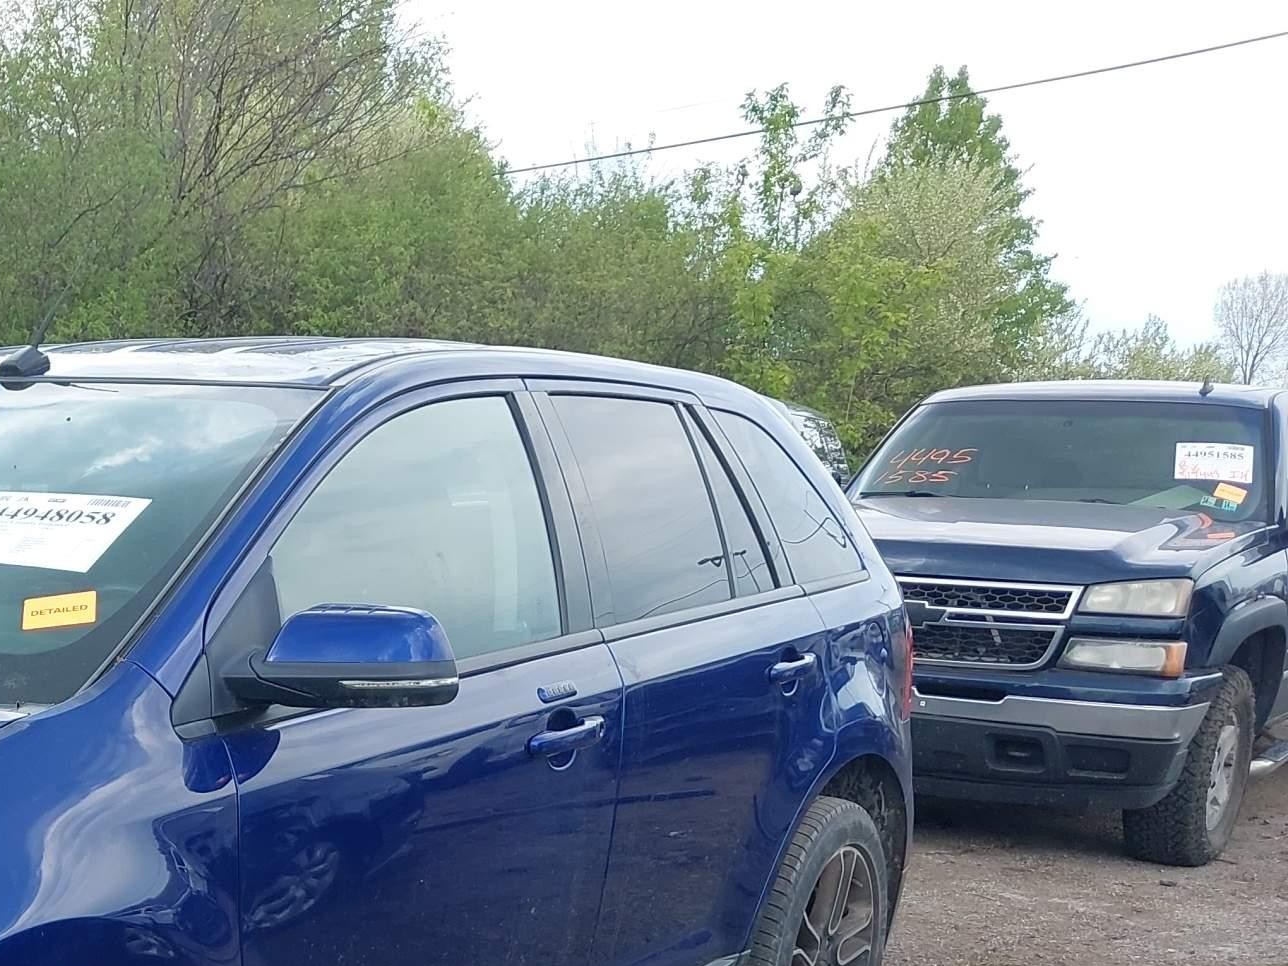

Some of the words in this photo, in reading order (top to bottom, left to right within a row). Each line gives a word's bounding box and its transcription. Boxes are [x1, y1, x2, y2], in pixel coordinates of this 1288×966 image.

[890, 448, 979, 469] 4495
[1184, 450, 1245, 461] 44951585
[873, 470, 959, 485] 1585
[30, 604, 89, 617] DETAILED
